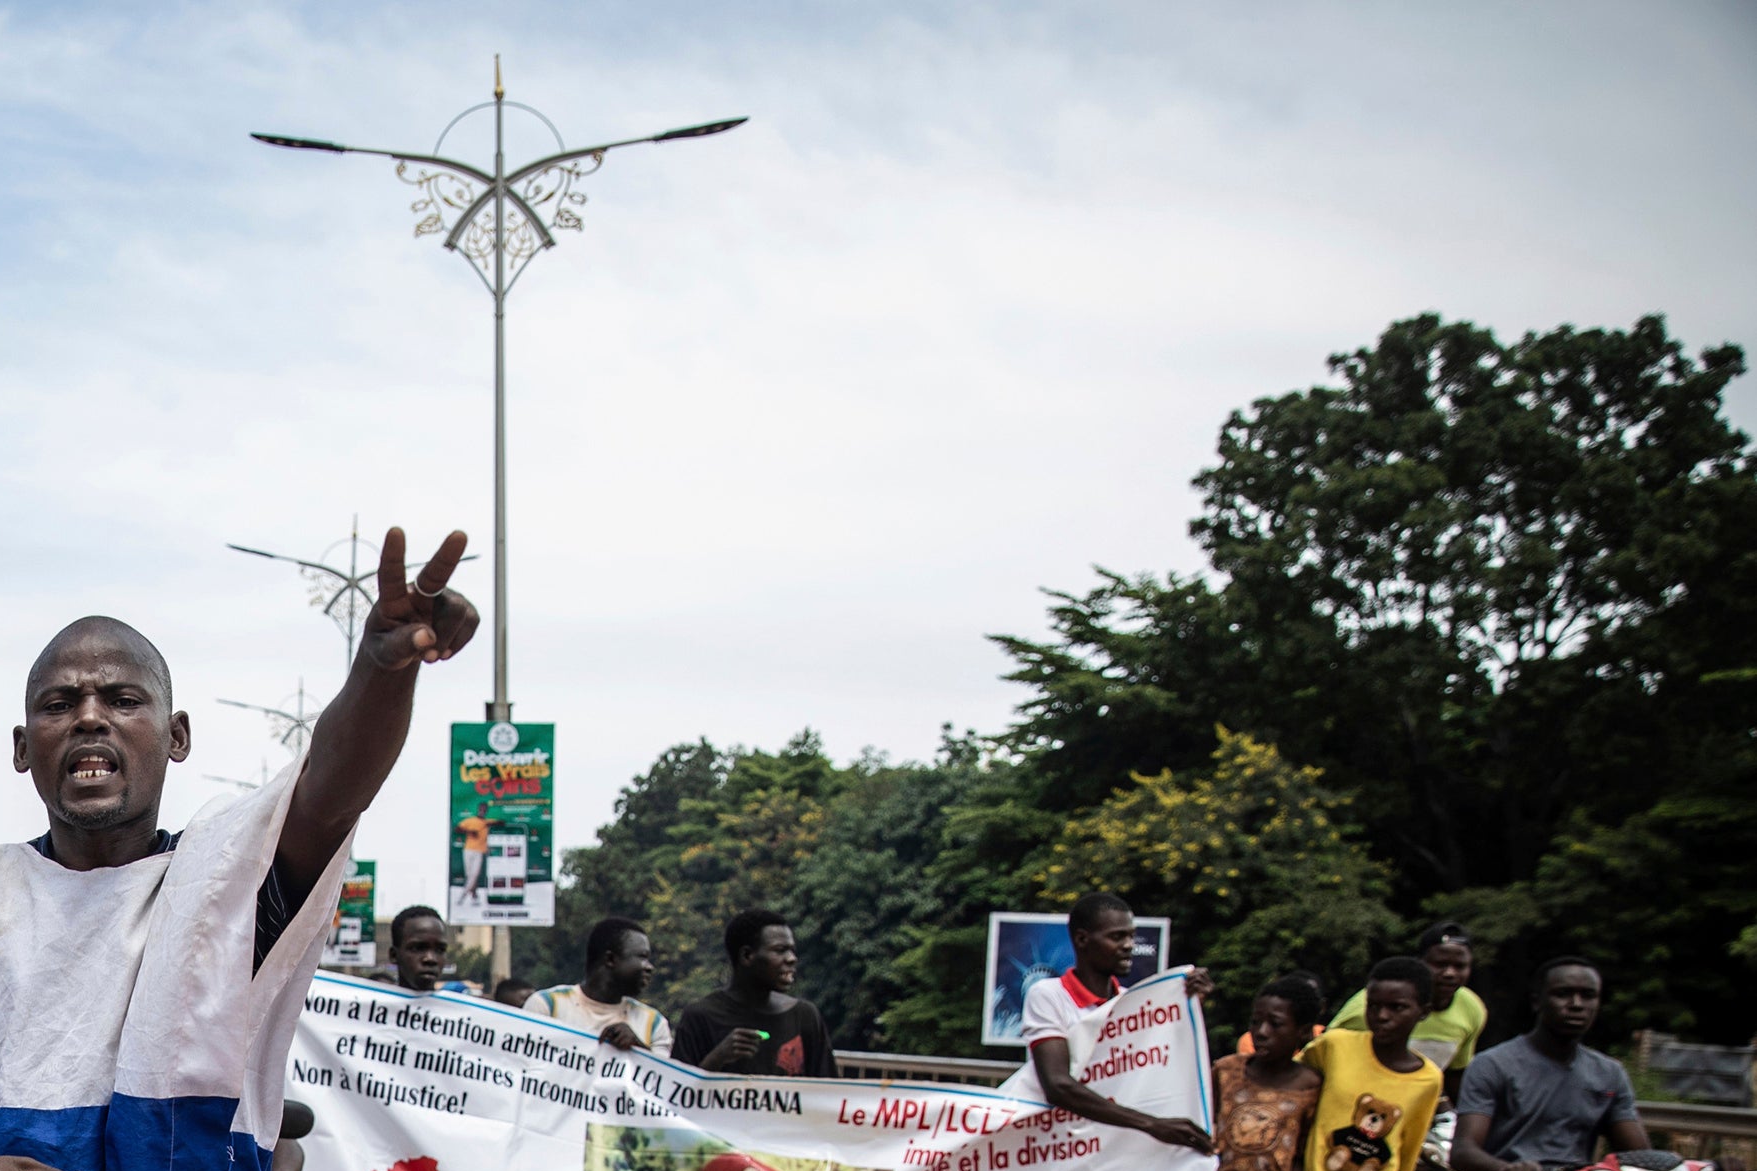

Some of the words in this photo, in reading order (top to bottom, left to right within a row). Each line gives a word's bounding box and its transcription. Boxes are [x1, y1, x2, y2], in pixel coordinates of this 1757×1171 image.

[336, 1034, 357, 1056] et
[364, 1036, 408, 1067] huit
[414, 1048, 514, 1089] militaires
[521, 1069, 609, 1114] inconnus
[616, 1091, 636, 1116] de
[348, 996, 361, 1020] à
[369, 1000, 388, 1025] la
[396, 1004, 495, 1047] détention
[501, 1032, 596, 1075] arbitraire
[601, 1057, 626, 1079] du
[632, 1065, 664, 1100] LCL
[669, 1080, 802, 1115] ZOUNGRANA
[292, 1059, 333, 1087] Non
[340, 1067, 351, 1091] à
[357, 1071, 468, 1115] l'injustice!
[838, 1099, 865, 1126] Le
[989, 1141, 1009, 1170] la
[1016, 1133, 1101, 1167] division
